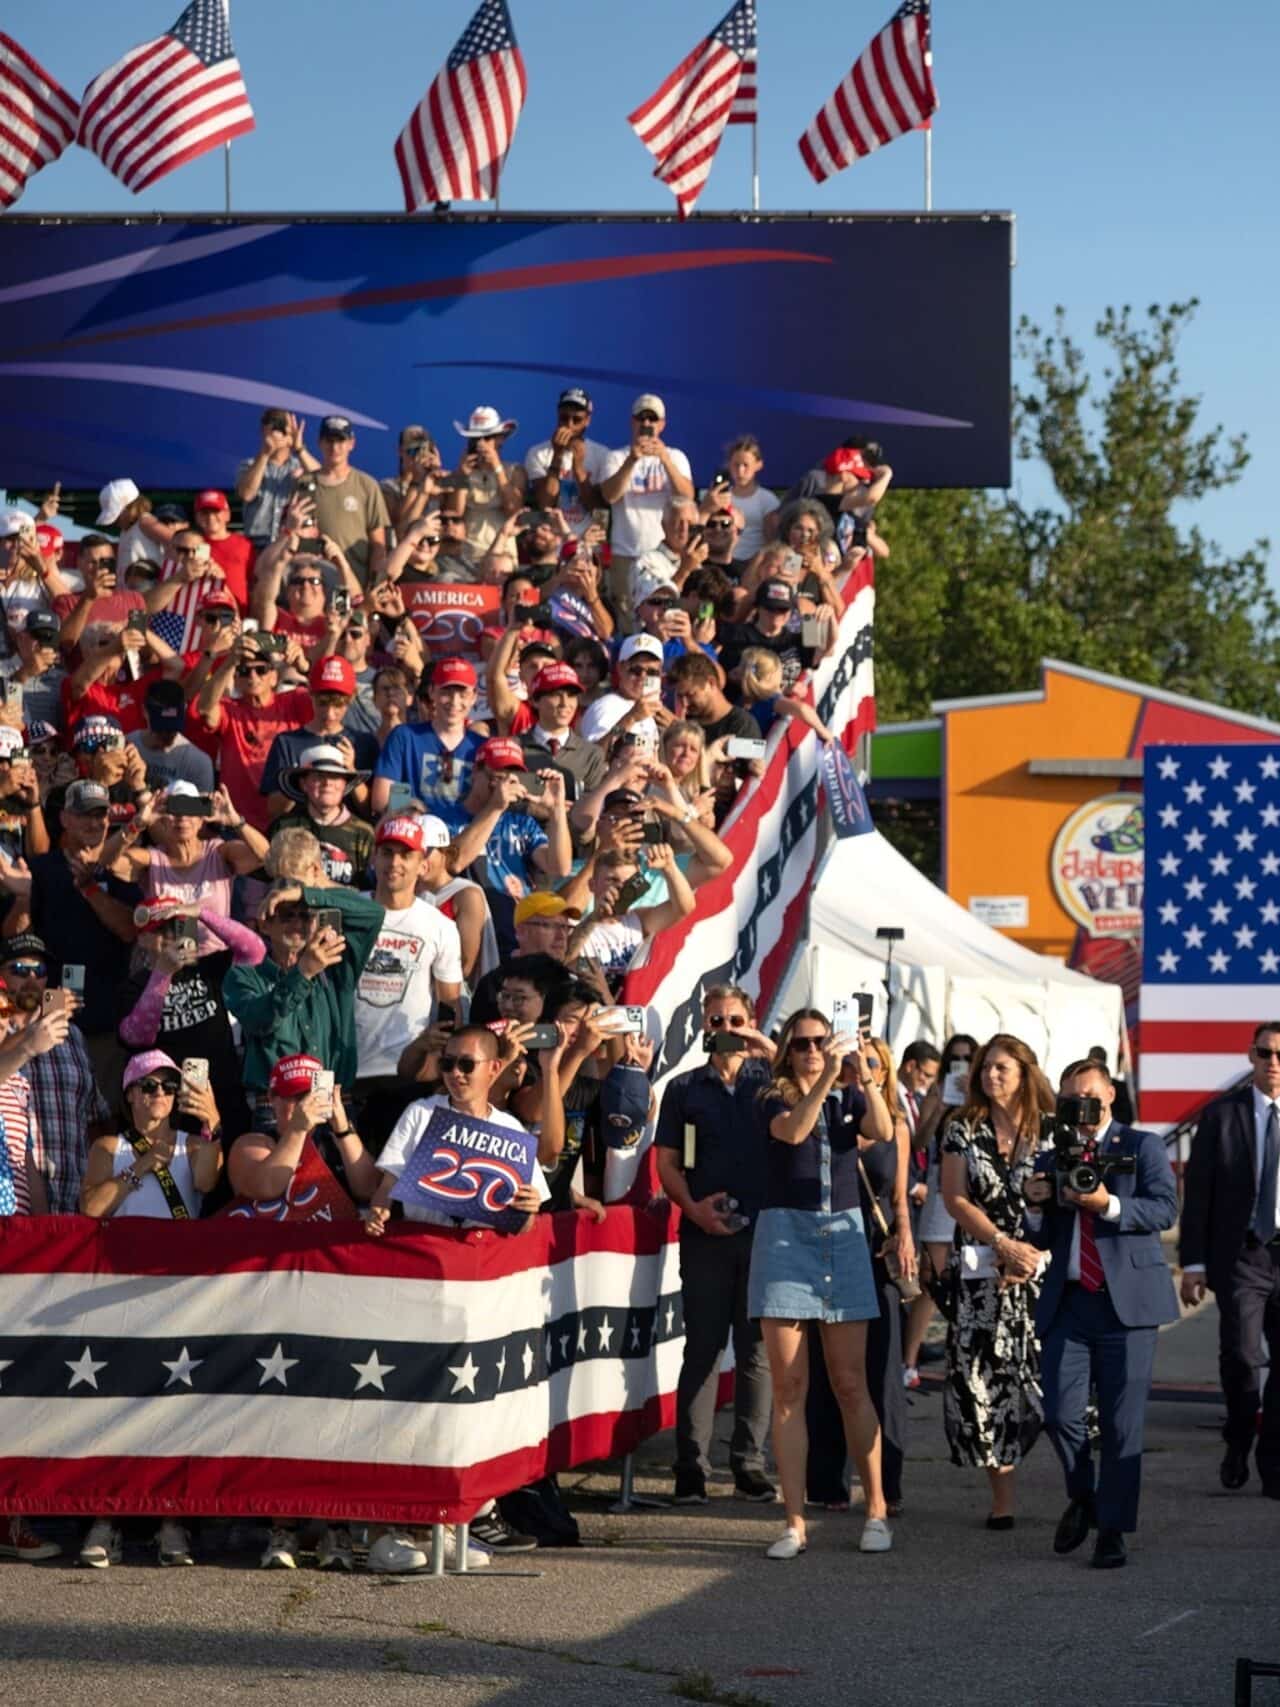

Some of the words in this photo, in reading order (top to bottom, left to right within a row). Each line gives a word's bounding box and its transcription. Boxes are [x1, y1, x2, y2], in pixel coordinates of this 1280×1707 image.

[412, 590, 485, 607] AMERICA
[823, 749, 847, 825] AMERICA
[321, 860, 353, 884] EWS
[1078, 879, 1144, 911] PET
[376, 937, 419, 954] UMP'S
[161, 1000, 217, 1032] HEEP
[441, 1124, 528, 1164] AMERICA
[418, 1147, 523, 1212] 250
